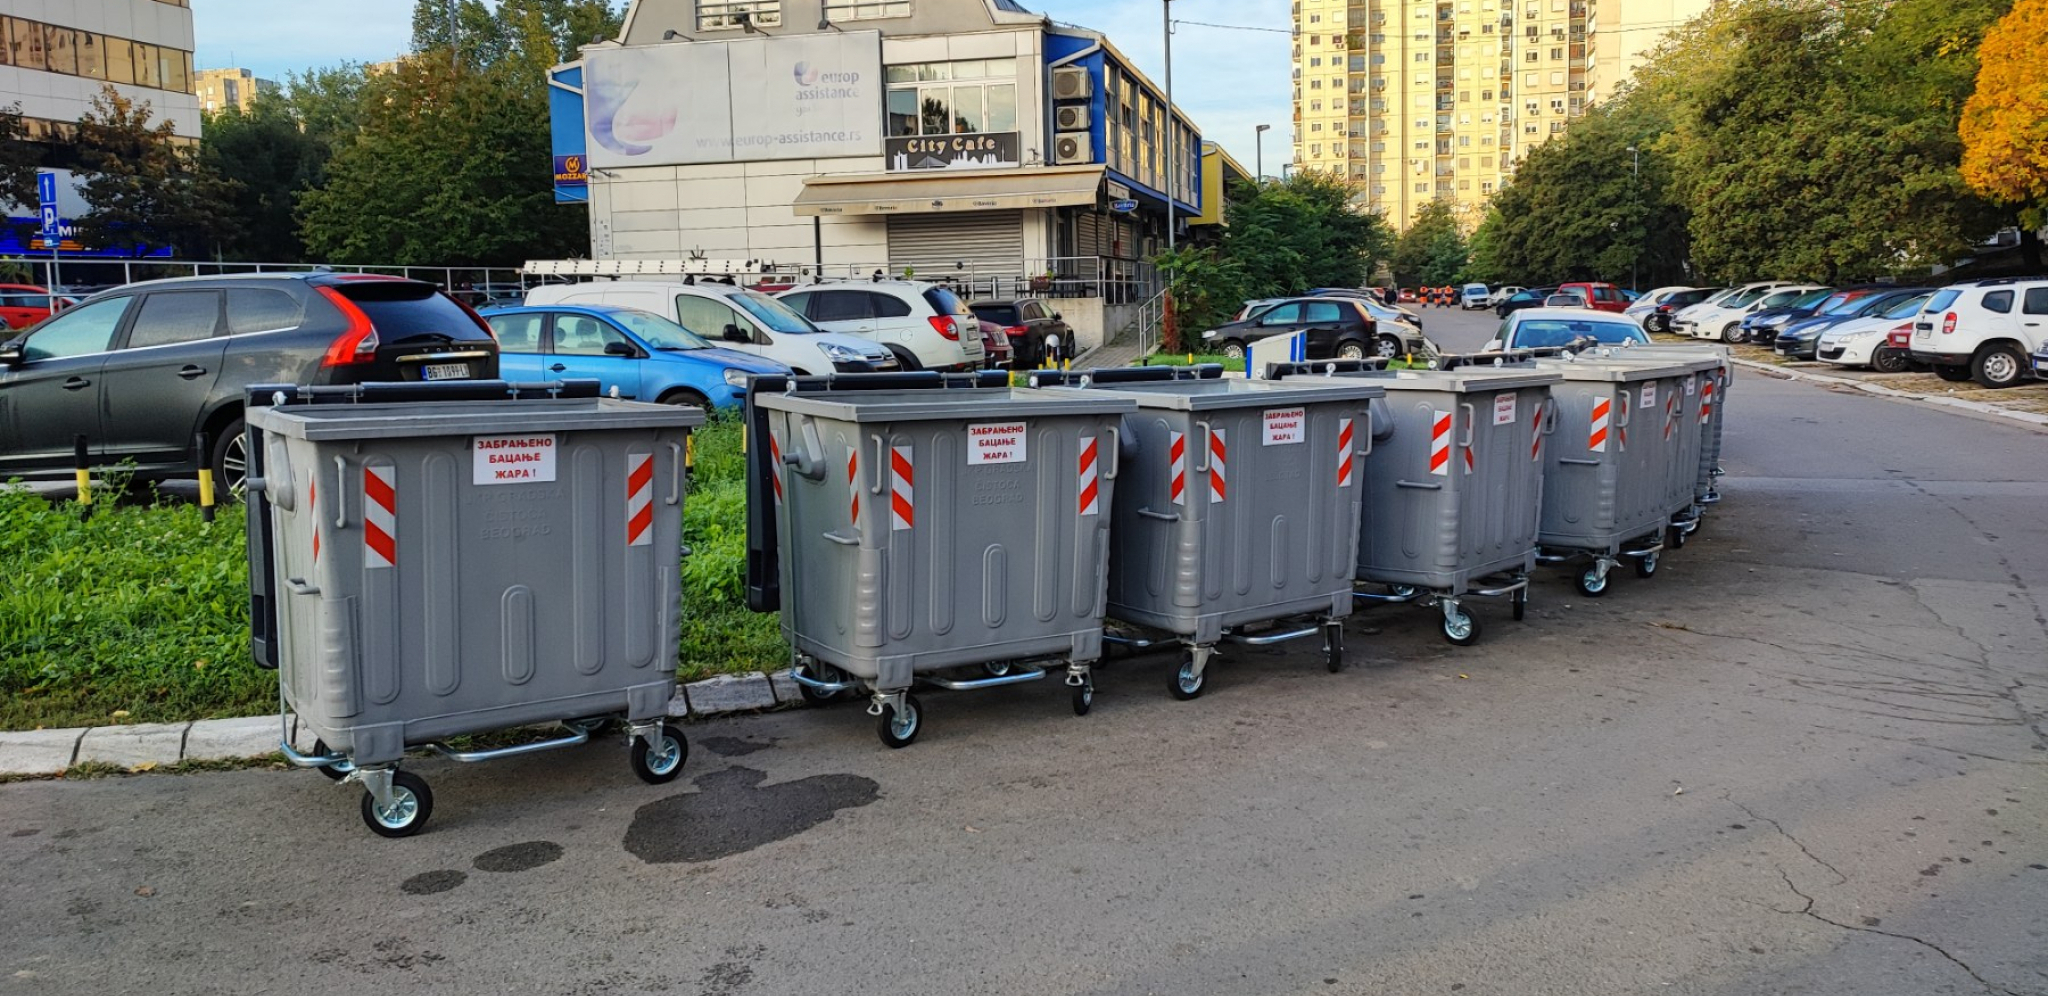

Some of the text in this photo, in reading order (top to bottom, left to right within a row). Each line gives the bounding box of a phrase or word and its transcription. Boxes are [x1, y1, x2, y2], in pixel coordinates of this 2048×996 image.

[821, 72, 860, 84] europ
[795, 86, 860, 101] assistance
[907, 136, 996, 155] City Cafe
[44, 207, 54, 232] P
[971, 425, 1024, 436] ЗАБРАЊЕНО
[477, 438, 553, 450] ЗАБРАЊЕНО
[978, 437, 1017, 448] БАЦАЊЕ
[488, 452, 541, 464] БАЦАЊЕ
[983, 451, 1008, 460] ЖАРА
[495, 469, 529, 479] ЖАРА
